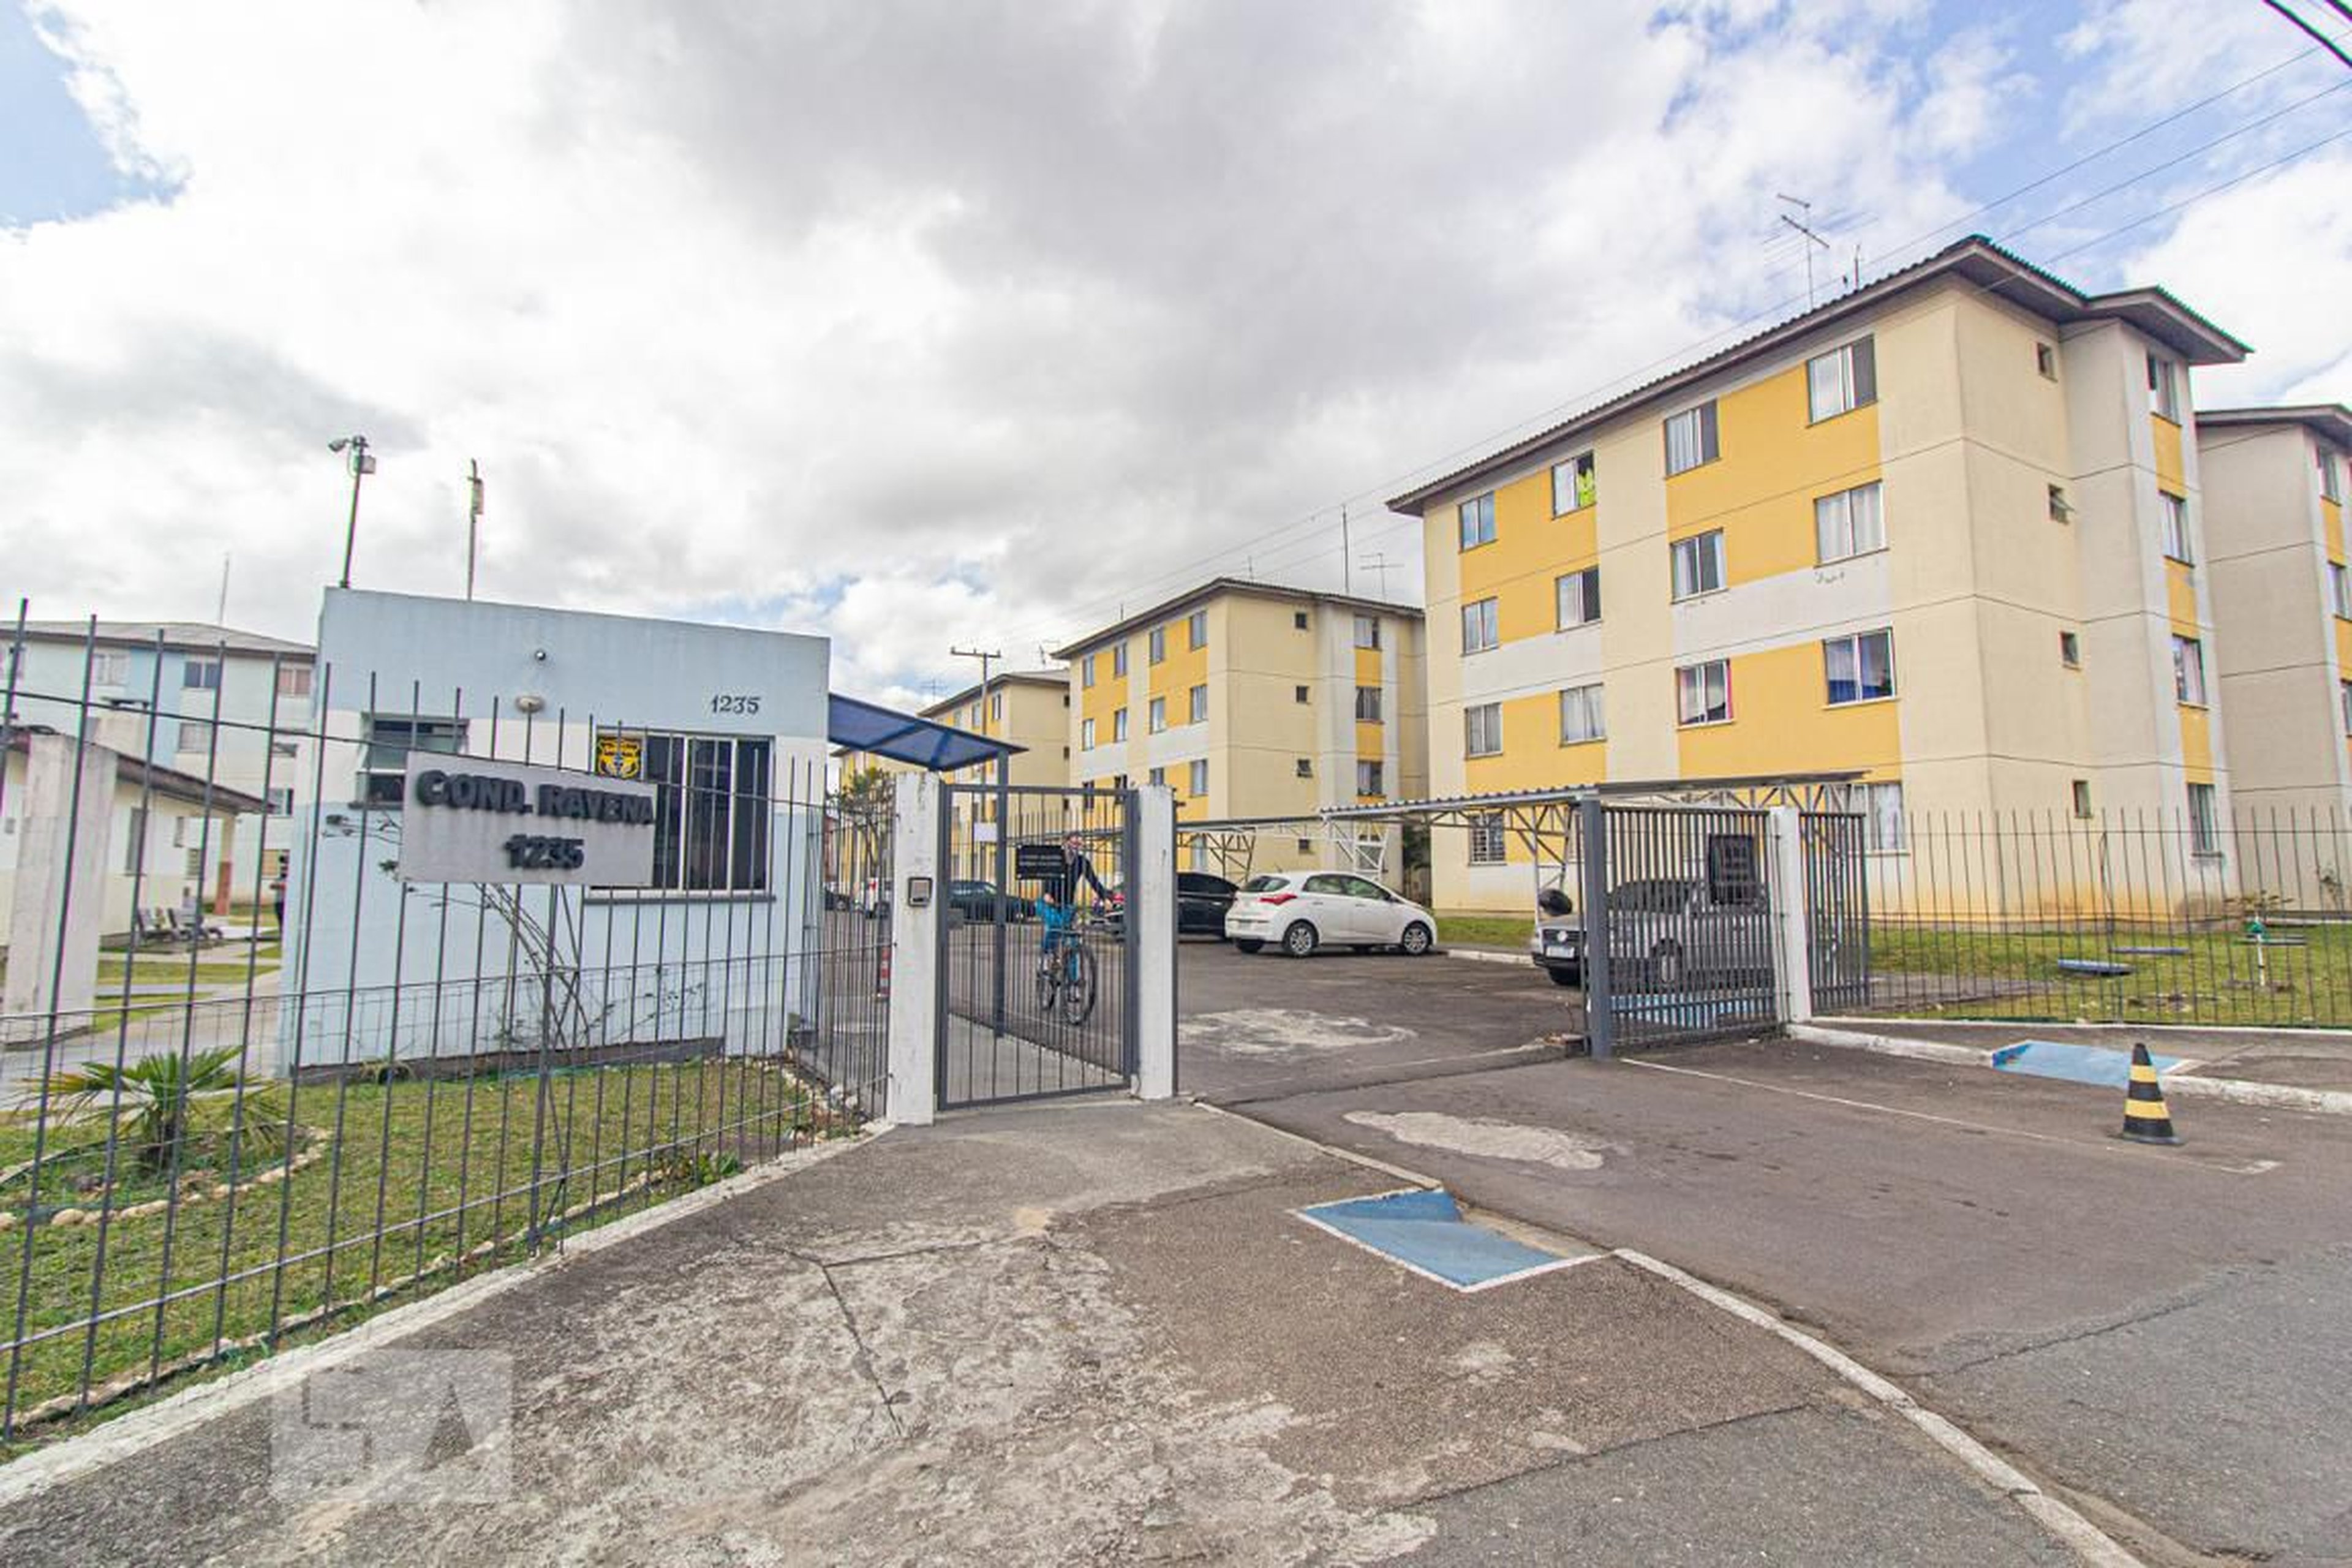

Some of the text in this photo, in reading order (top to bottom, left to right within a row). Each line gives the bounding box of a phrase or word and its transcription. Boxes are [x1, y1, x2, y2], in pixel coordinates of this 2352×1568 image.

[711, 694, 761, 715] 1235
[415, 769, 655, 826] COND. RAVENA
[503, 834, 586, 870] 1235
